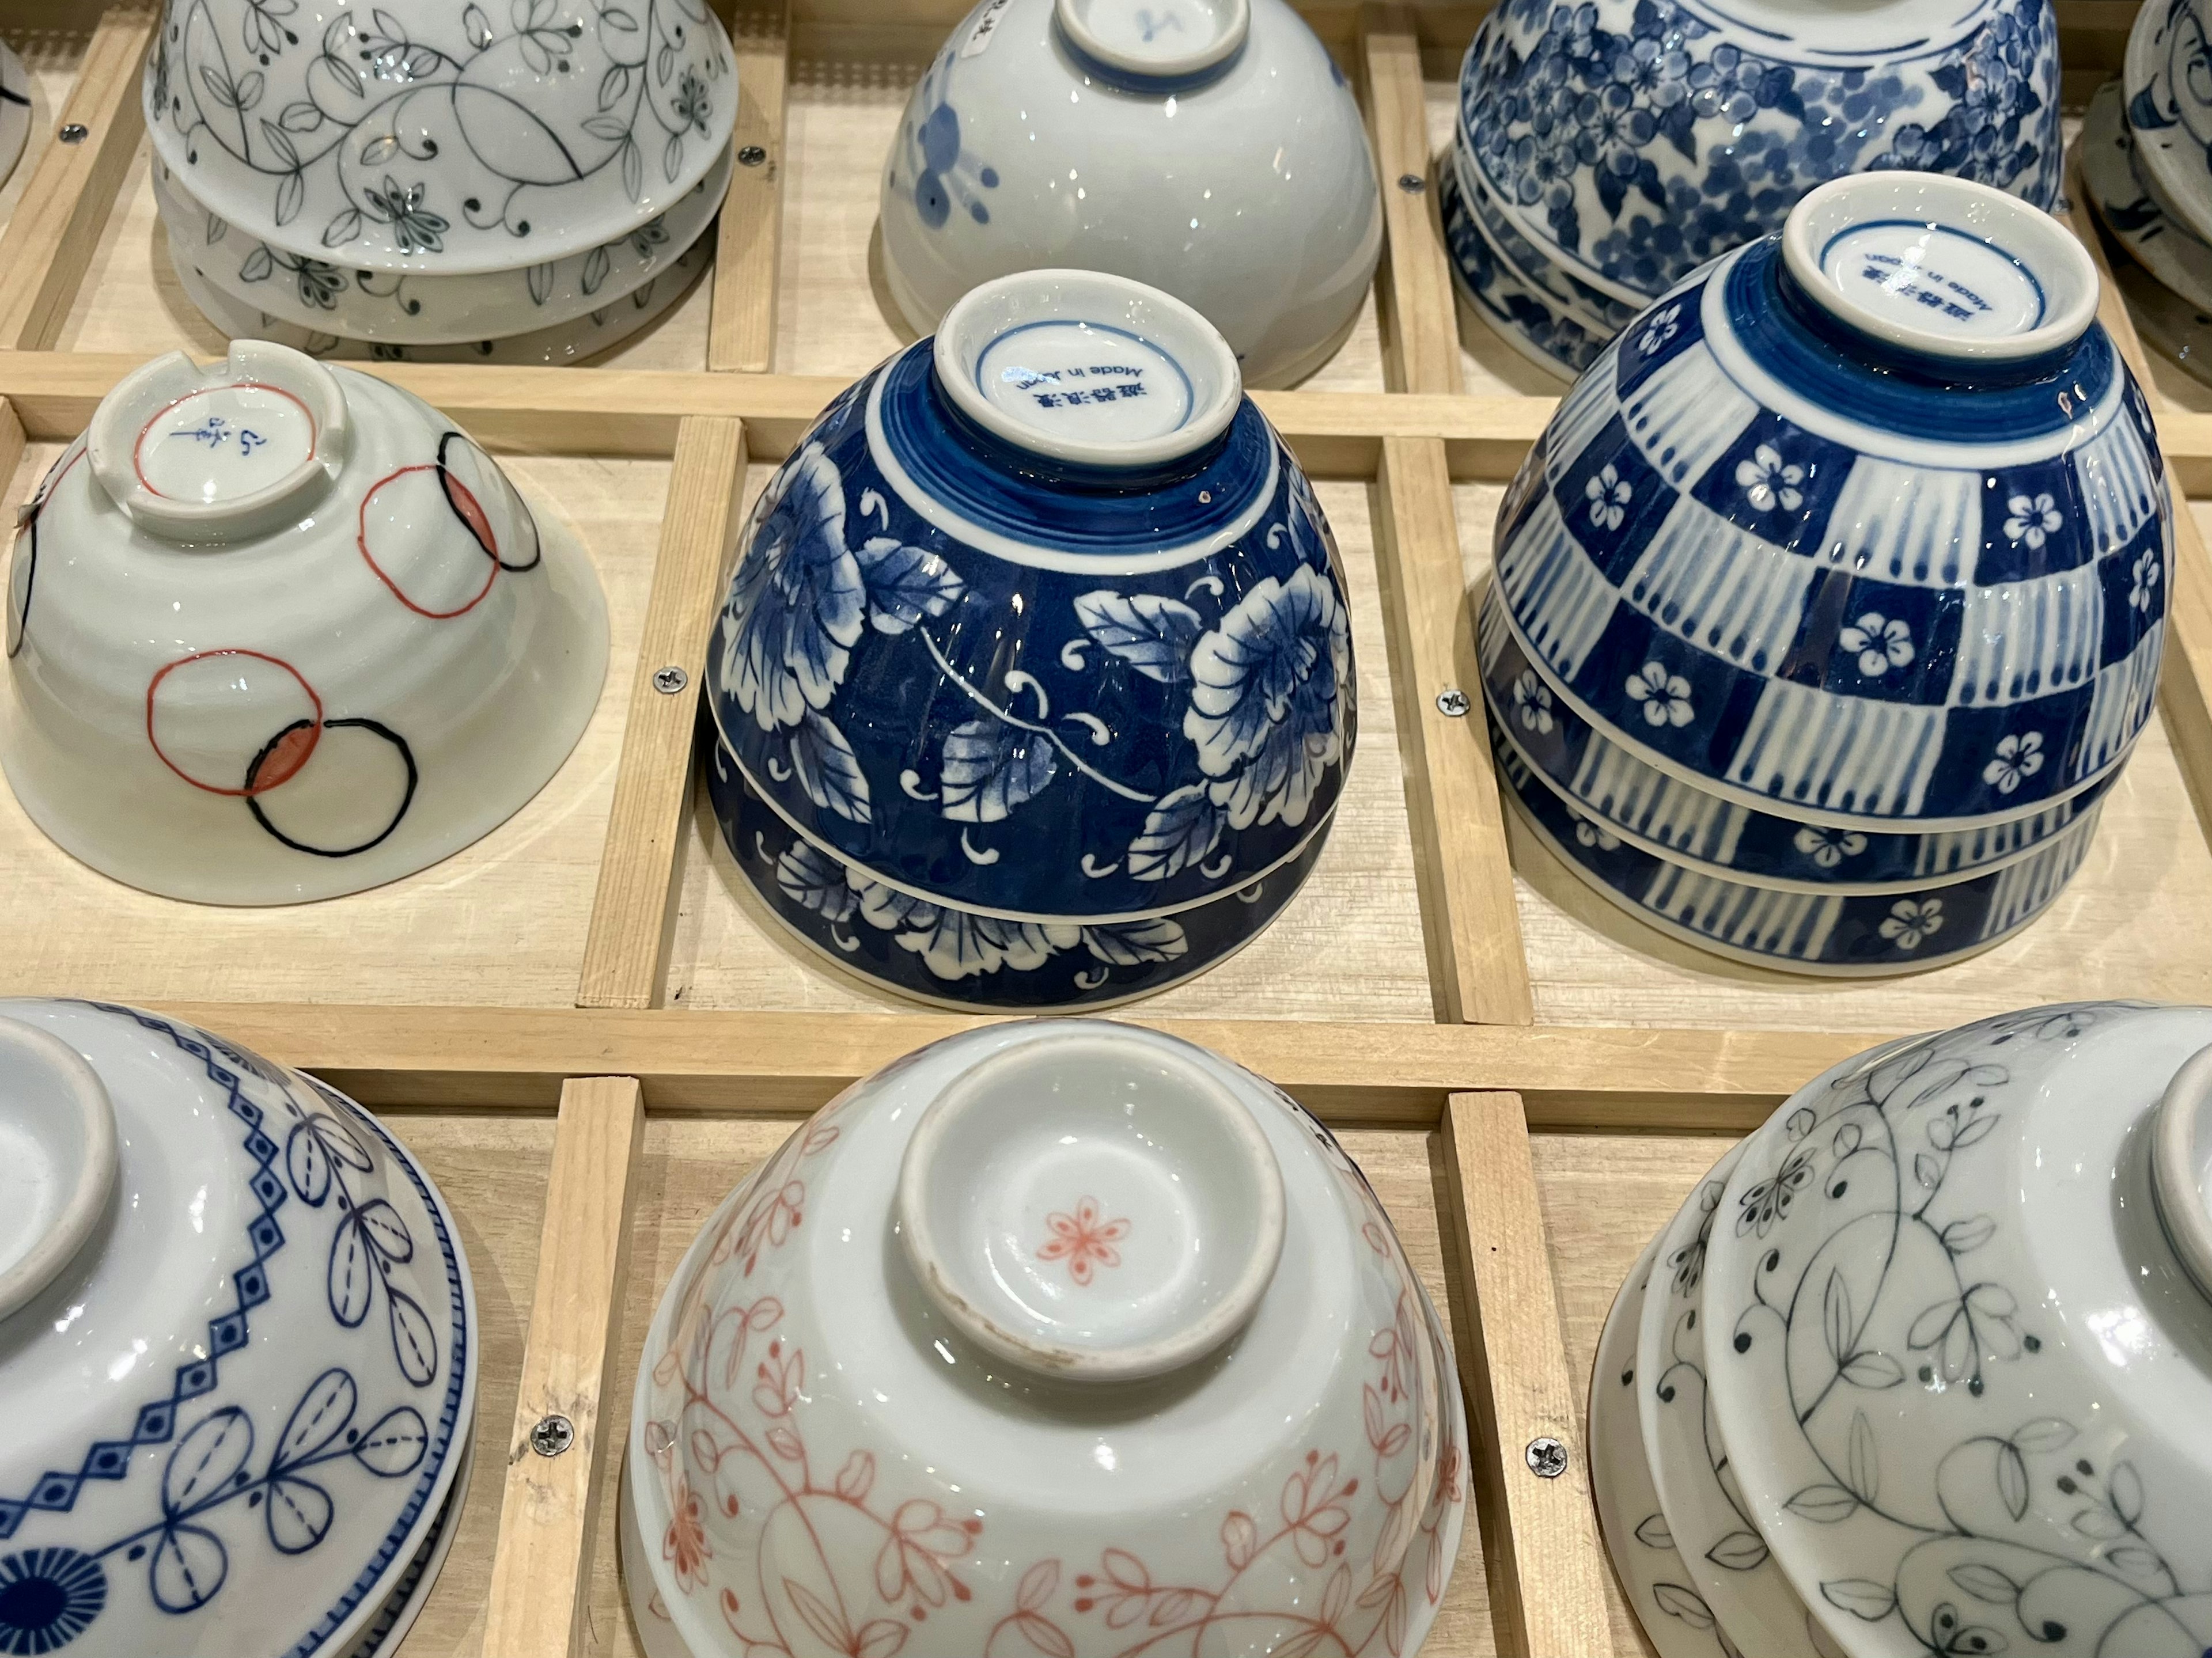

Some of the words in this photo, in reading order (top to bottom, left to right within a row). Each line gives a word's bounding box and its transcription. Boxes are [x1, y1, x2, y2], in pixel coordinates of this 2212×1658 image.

[1865, 253, 1922, 270] pan
[1948, 282, 1993, 311] Made
[1089, 366, 1143, 378] Made
